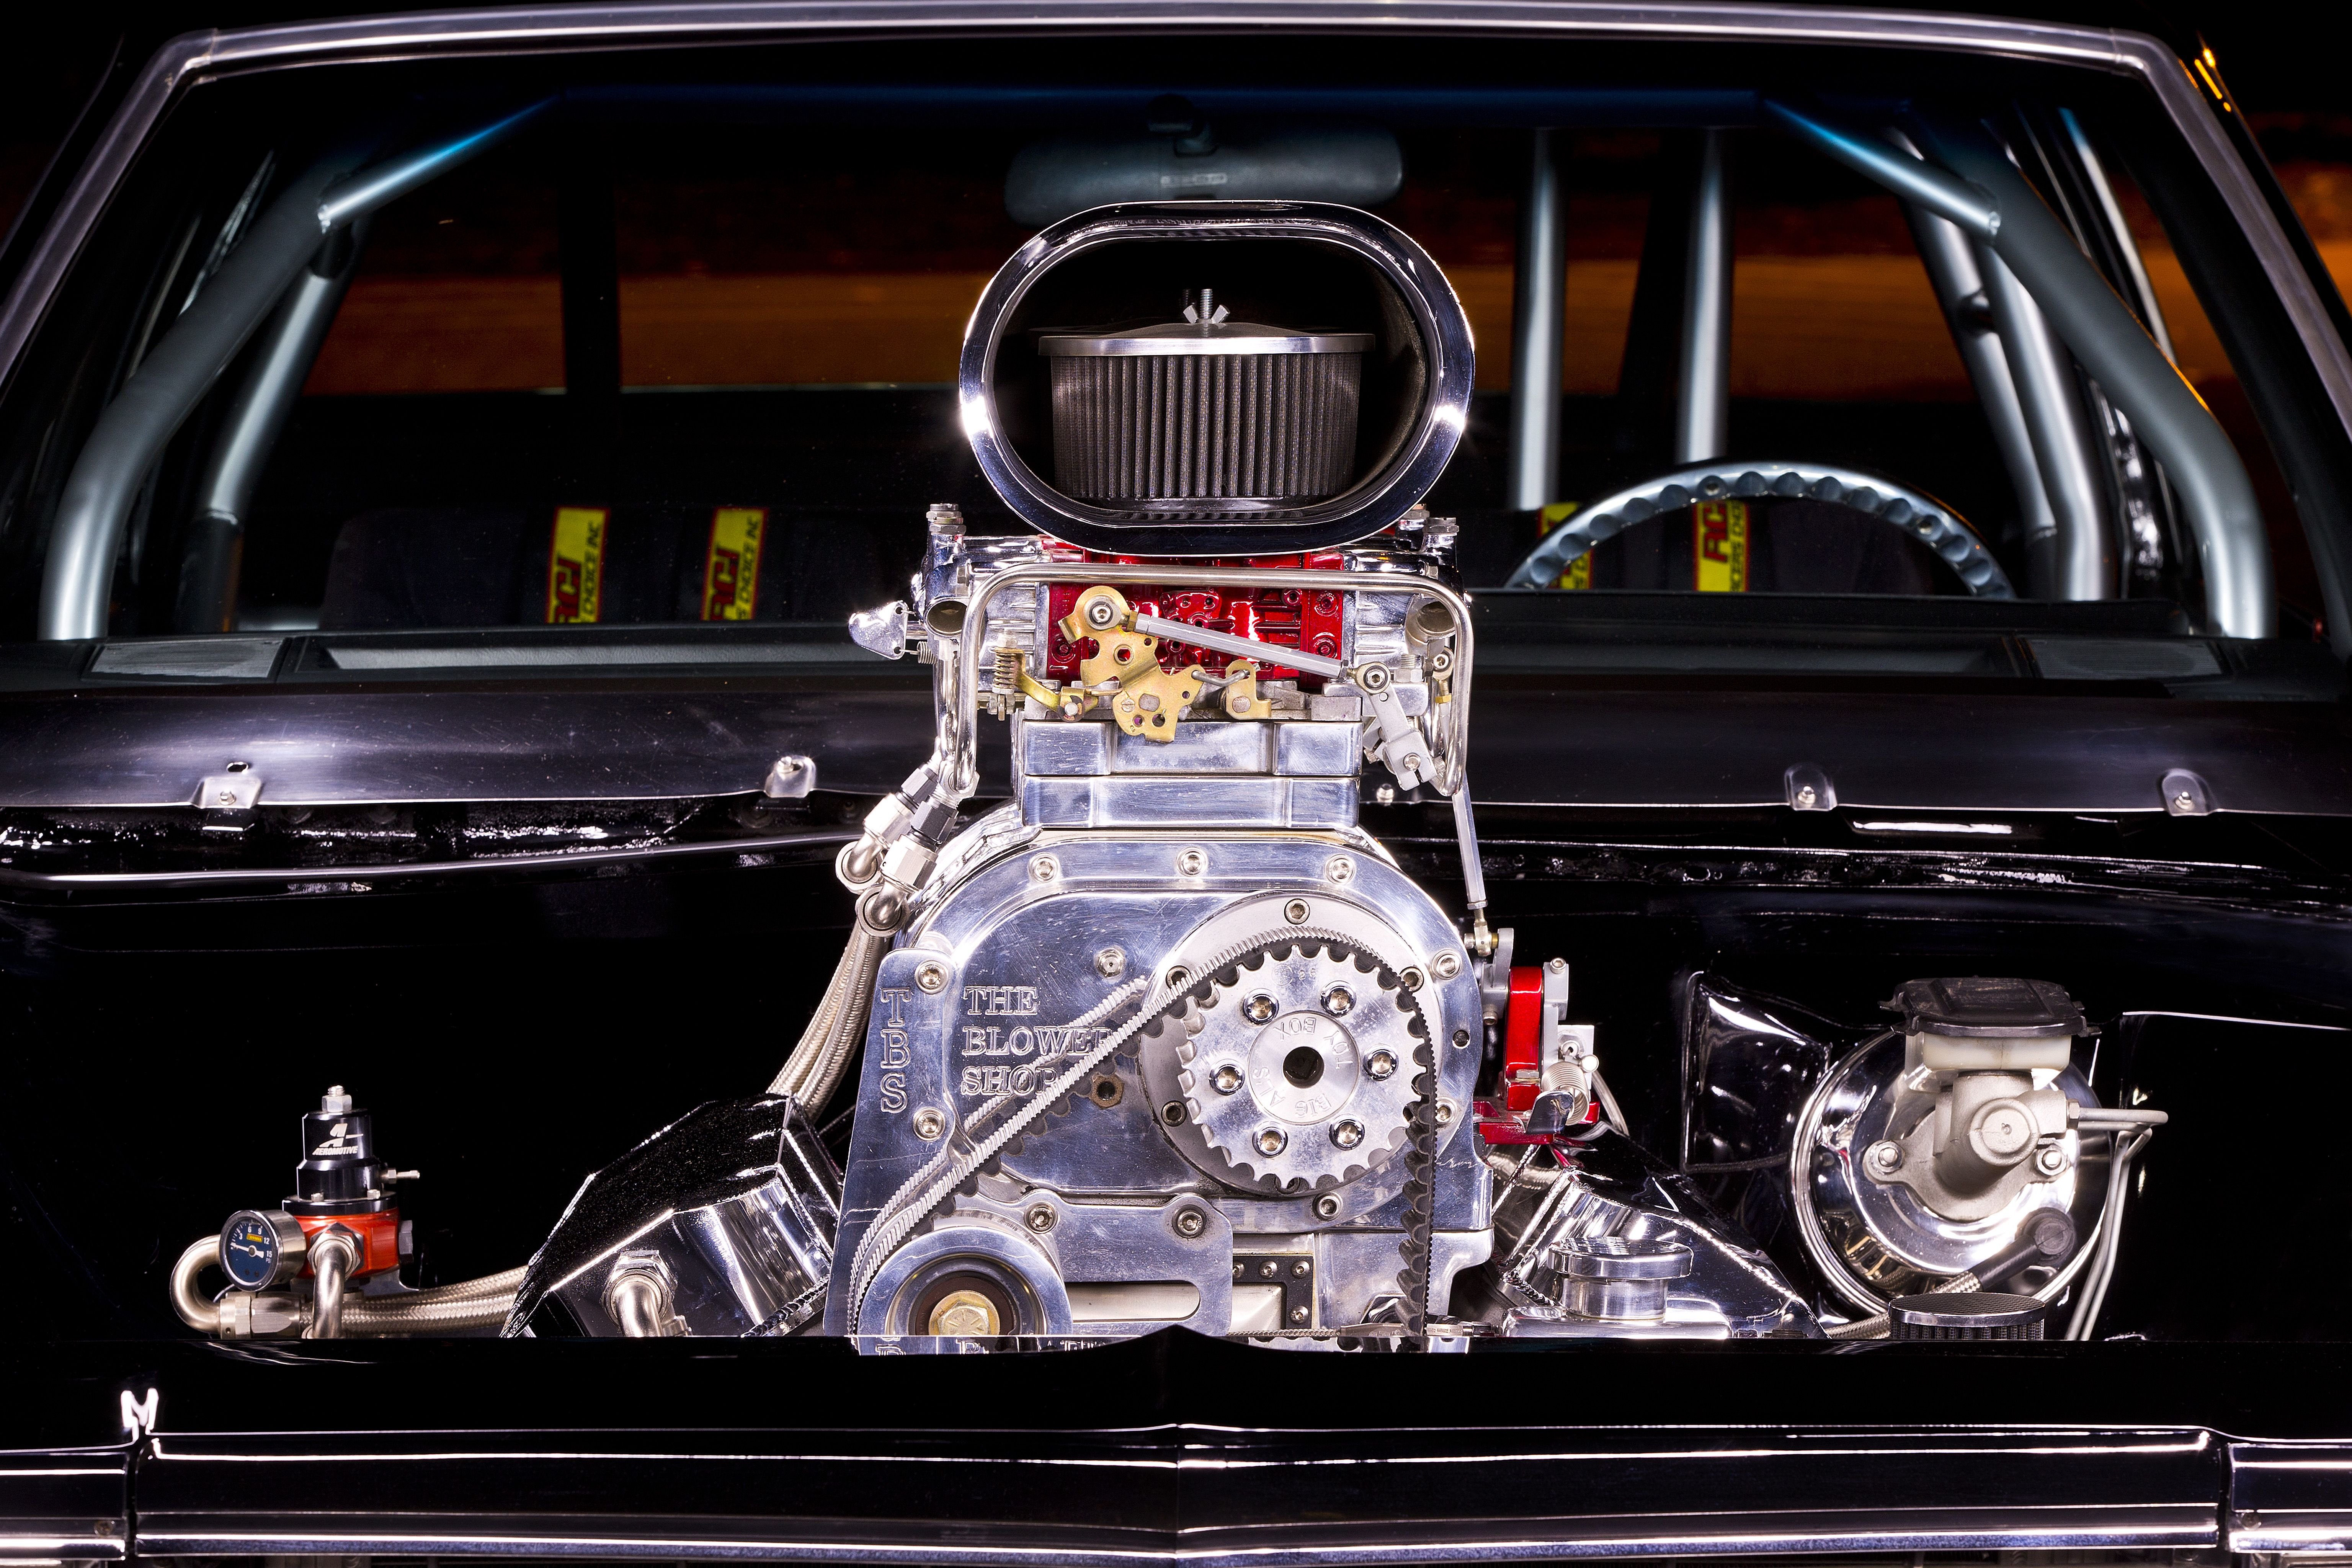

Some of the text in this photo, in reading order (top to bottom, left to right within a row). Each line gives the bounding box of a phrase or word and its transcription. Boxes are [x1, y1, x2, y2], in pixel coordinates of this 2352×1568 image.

[962, 985, 1038, 1016] THE
[1274, 1017, 1317, 1042] BOX
[880, 987, 911, 1114] TBS
[1324, 1031, 1353, 1069] TOY
[960, 1064, 1058, 1096] SHOP
[1294, 1093, 1332, 1118] BIG
[312, 1145, 358, 1156] AEROMOTIVE
